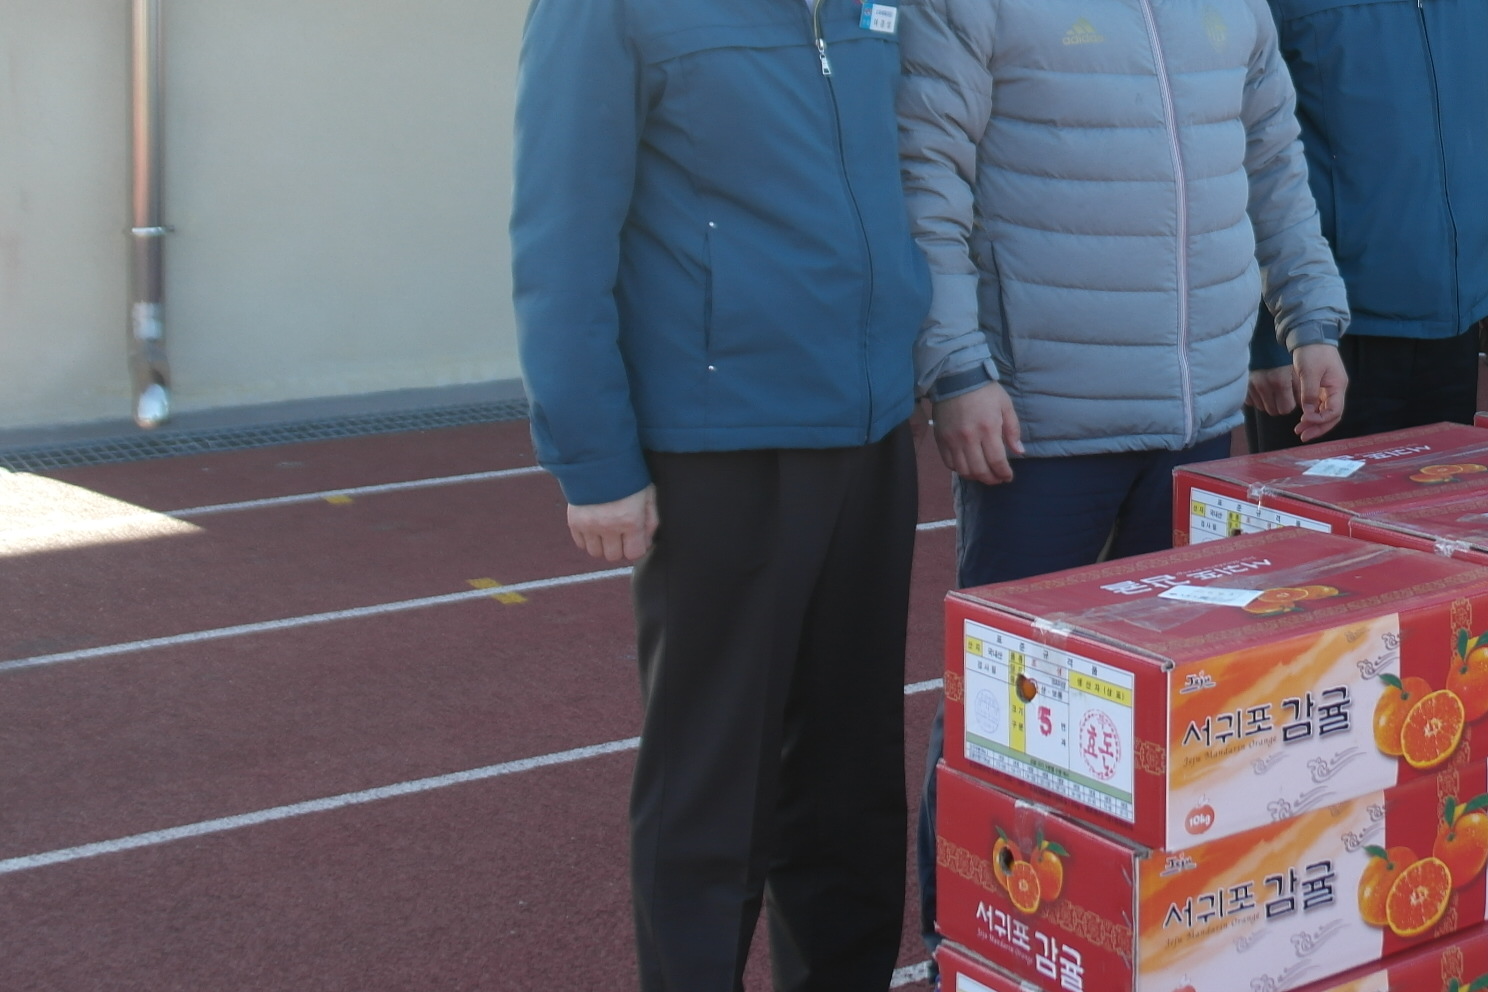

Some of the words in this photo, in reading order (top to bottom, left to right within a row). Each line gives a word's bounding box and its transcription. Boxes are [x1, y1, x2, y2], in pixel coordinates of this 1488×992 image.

[1062, 34, 1105, 46] adidas
[1037, 705, 1053, 737] 5
[1182, 703, 1274, 747] 서귀포
[1282, 686, 1352, 743] 감귤
[1163, 881, 1256, 929] 서귀포
[1263, 859, 1336, 920] 감귤
[976, 900, 1032, 951] 서귀포
[1034, 930, 1085, 992] 감귤
